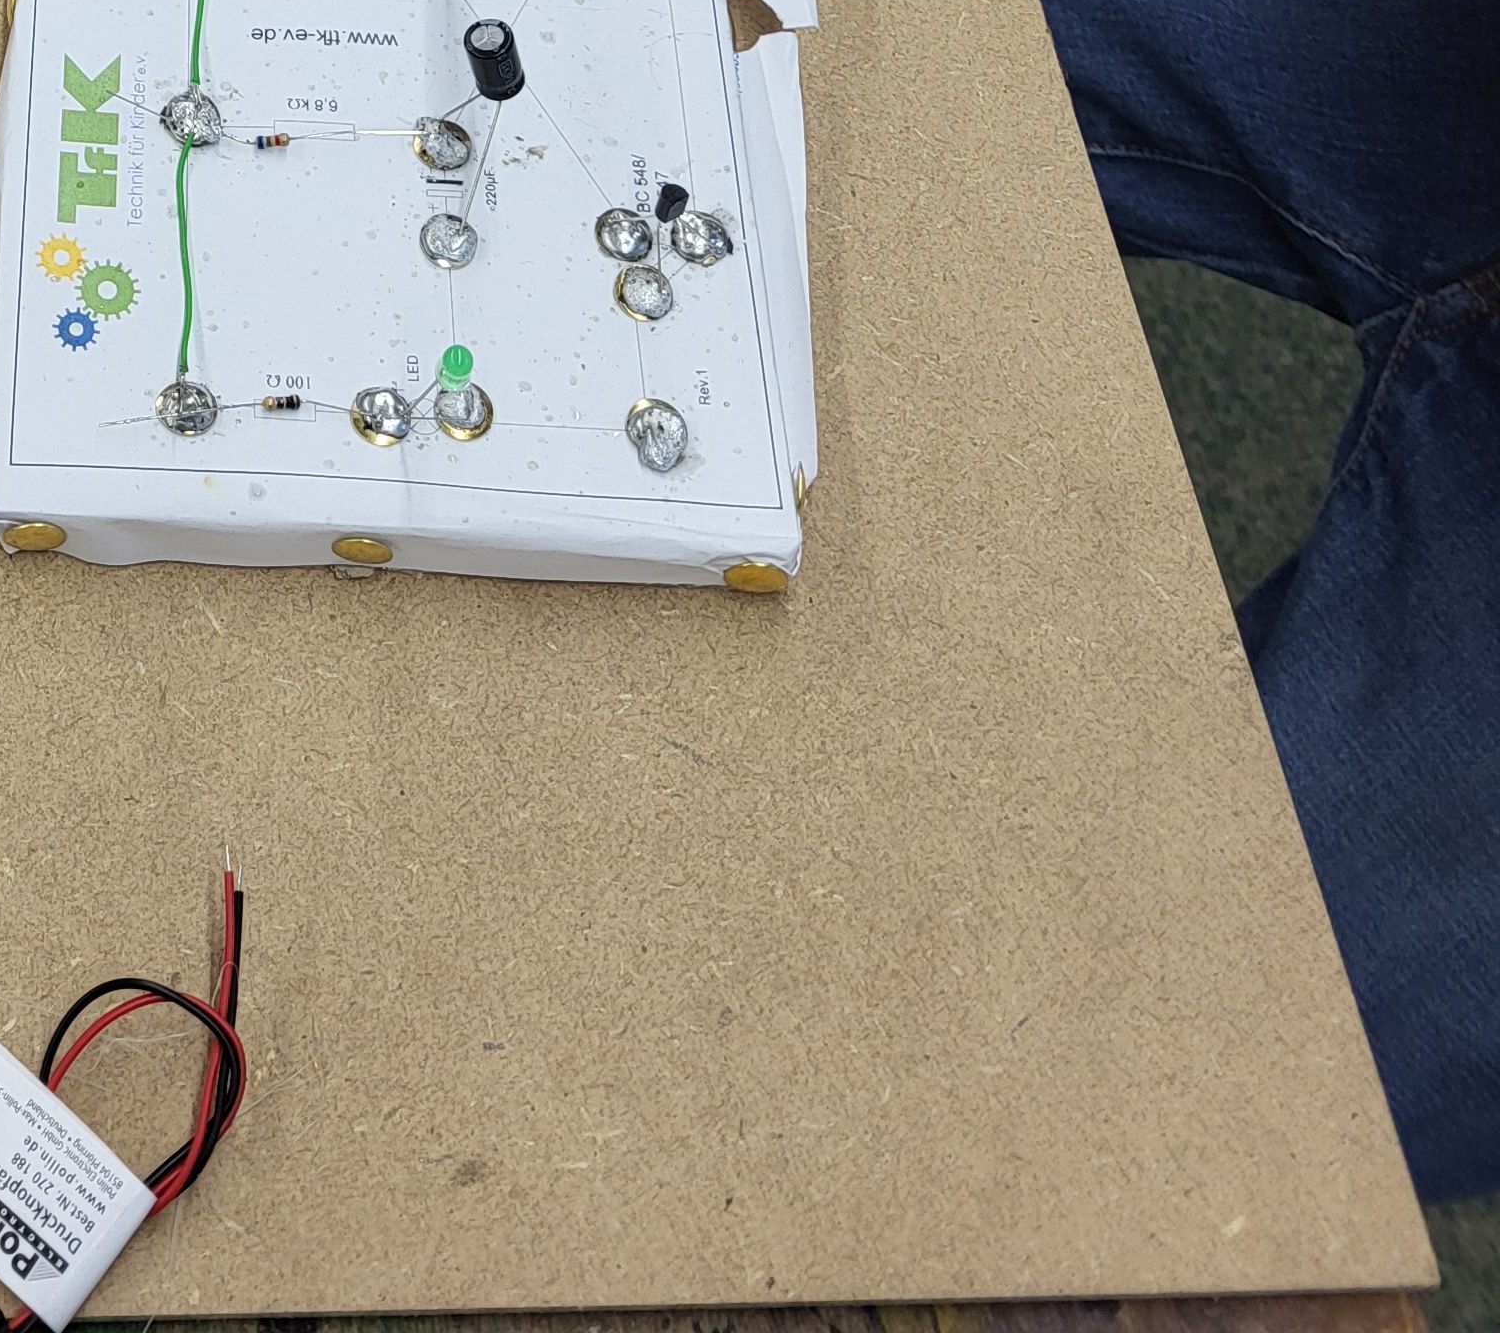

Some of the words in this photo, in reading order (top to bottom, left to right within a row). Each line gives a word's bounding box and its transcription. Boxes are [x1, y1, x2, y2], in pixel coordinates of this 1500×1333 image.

[251, 27, 399, 46] www.tfk-ev.de
[132, 77, 147, 130] Kinder
[57, 52, 122, 225] TfK
[129, 143, 144, 174] für
[127, 177, 143, 227] Technik
[636, 189, 651, 214] BC
[286, 374, 312, 390] 100
[406, 354, 420, 383] LED
[698, 369, 712, 406] Rev.1
[24, 1098, 68, 1139] Deutschland
[39, 1126, 65, 1152] GmbH
[9, 1150, 32, 1175] 188
[19, 1133, 109, 1215] www.pollin.de
[60, 1145, 98, 1182] Electronic
[97, 1164, 124, 1190] 85104
[30, 1170, 54, 1195] 270
[93, 1175, 118, 1199] Pollin
[50, 1189, 96, 1233] Best.Nr.
